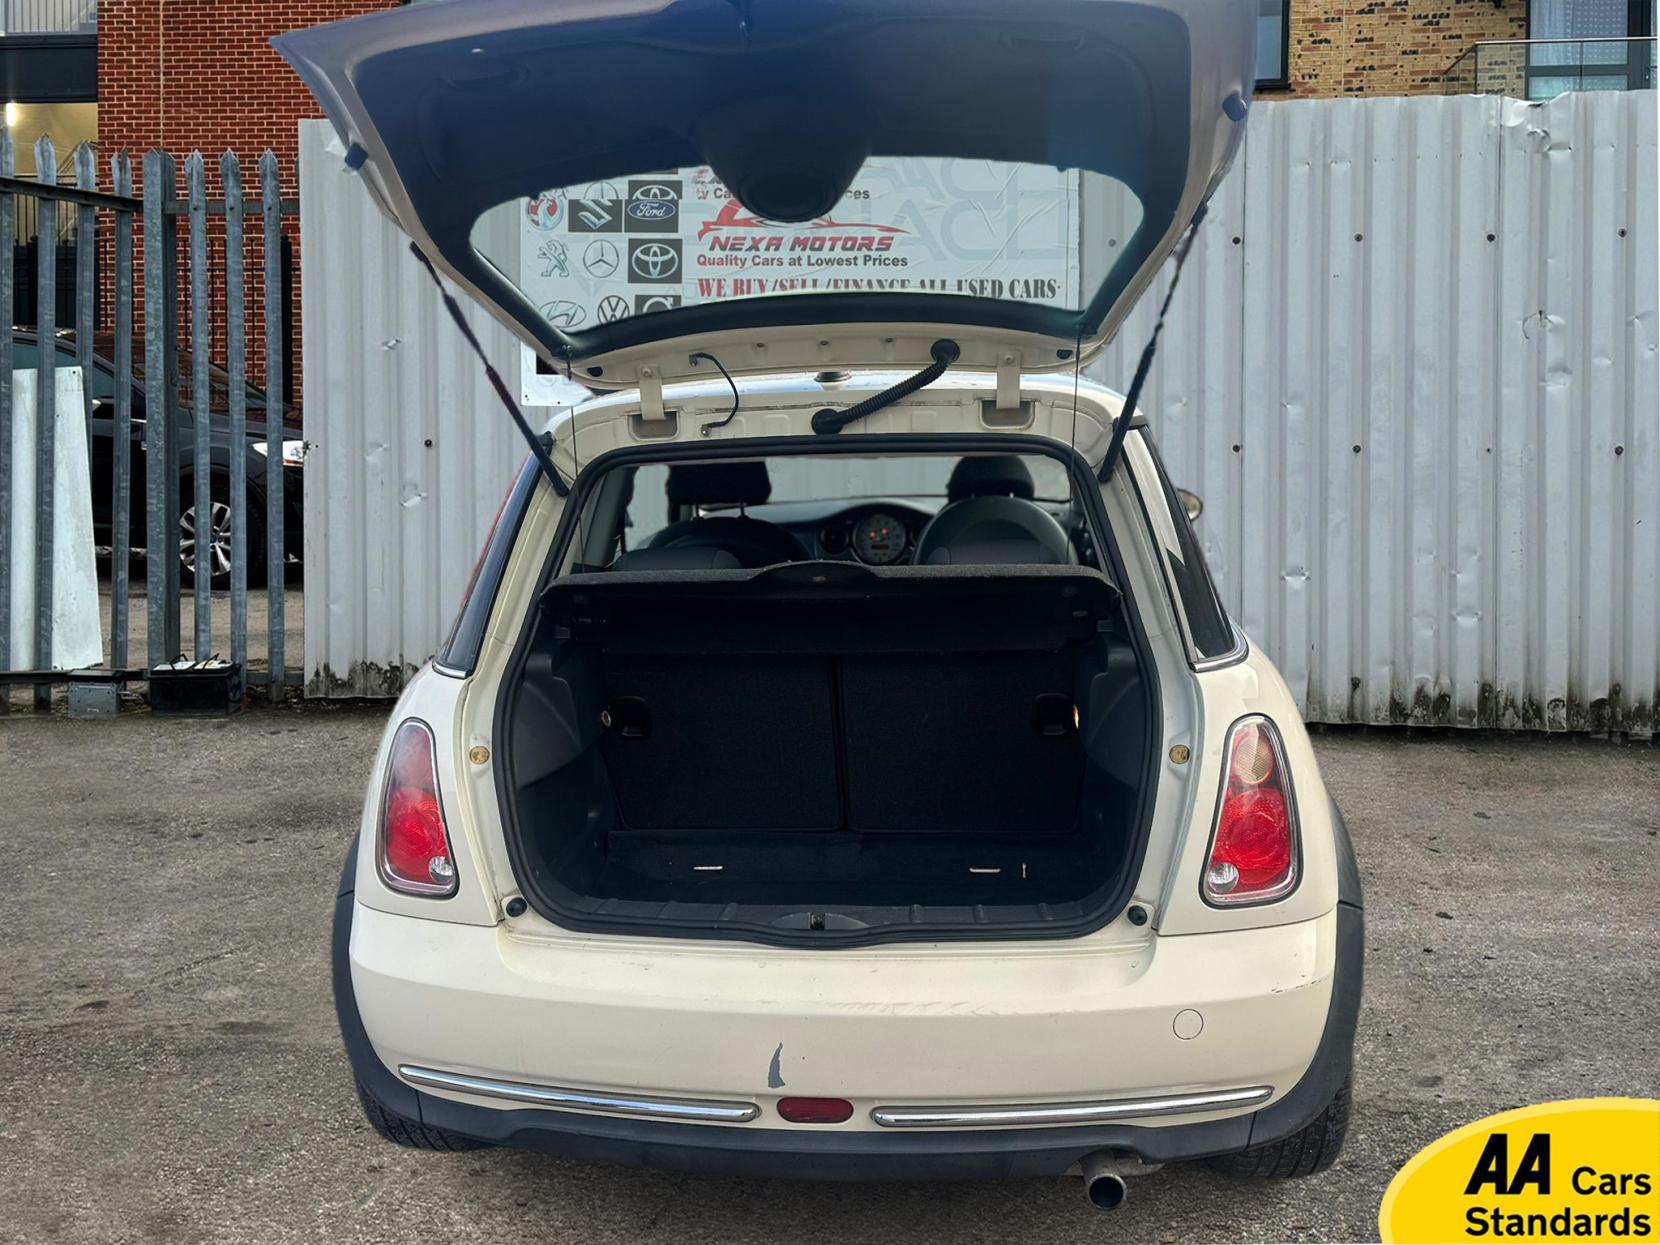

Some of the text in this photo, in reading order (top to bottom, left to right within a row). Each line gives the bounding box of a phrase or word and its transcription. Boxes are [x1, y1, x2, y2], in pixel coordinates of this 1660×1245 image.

[636, 203, 666, 217] Ford
[709, 236, 895, 252] NEXA MOTORS
[696, 254, 908, 269] Quality Cars at Lowest Prices
[697, 278, 726, 297] WE
[957, 279, 1004, 299] USED
